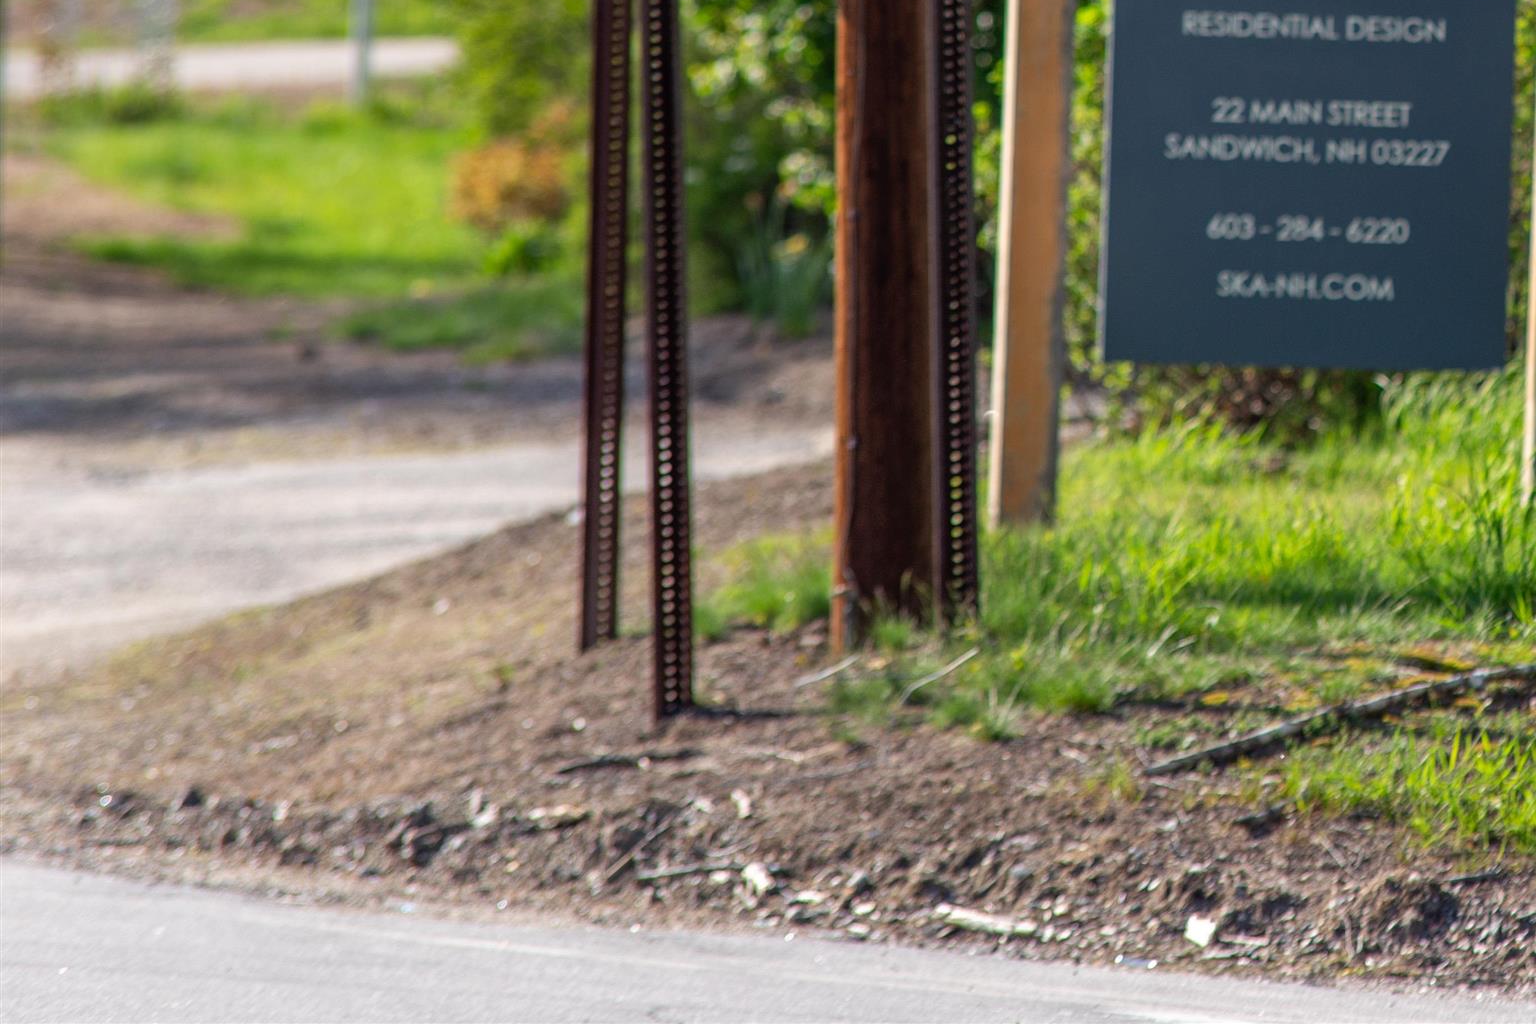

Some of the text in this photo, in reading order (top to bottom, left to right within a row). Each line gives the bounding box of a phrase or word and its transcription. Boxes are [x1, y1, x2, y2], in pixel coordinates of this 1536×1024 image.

[1182, 10, 1447, 43] RESIDENTIAL DESIGN
[1211, 96, 1412, 127] 22 MAIN STREET
[1163, 133, 1451, 166] SANDWICH, NH 03227
[1205, 213, 1255, 240] 603
[1216, 271, 1396, 302] SKA-NH.COM
